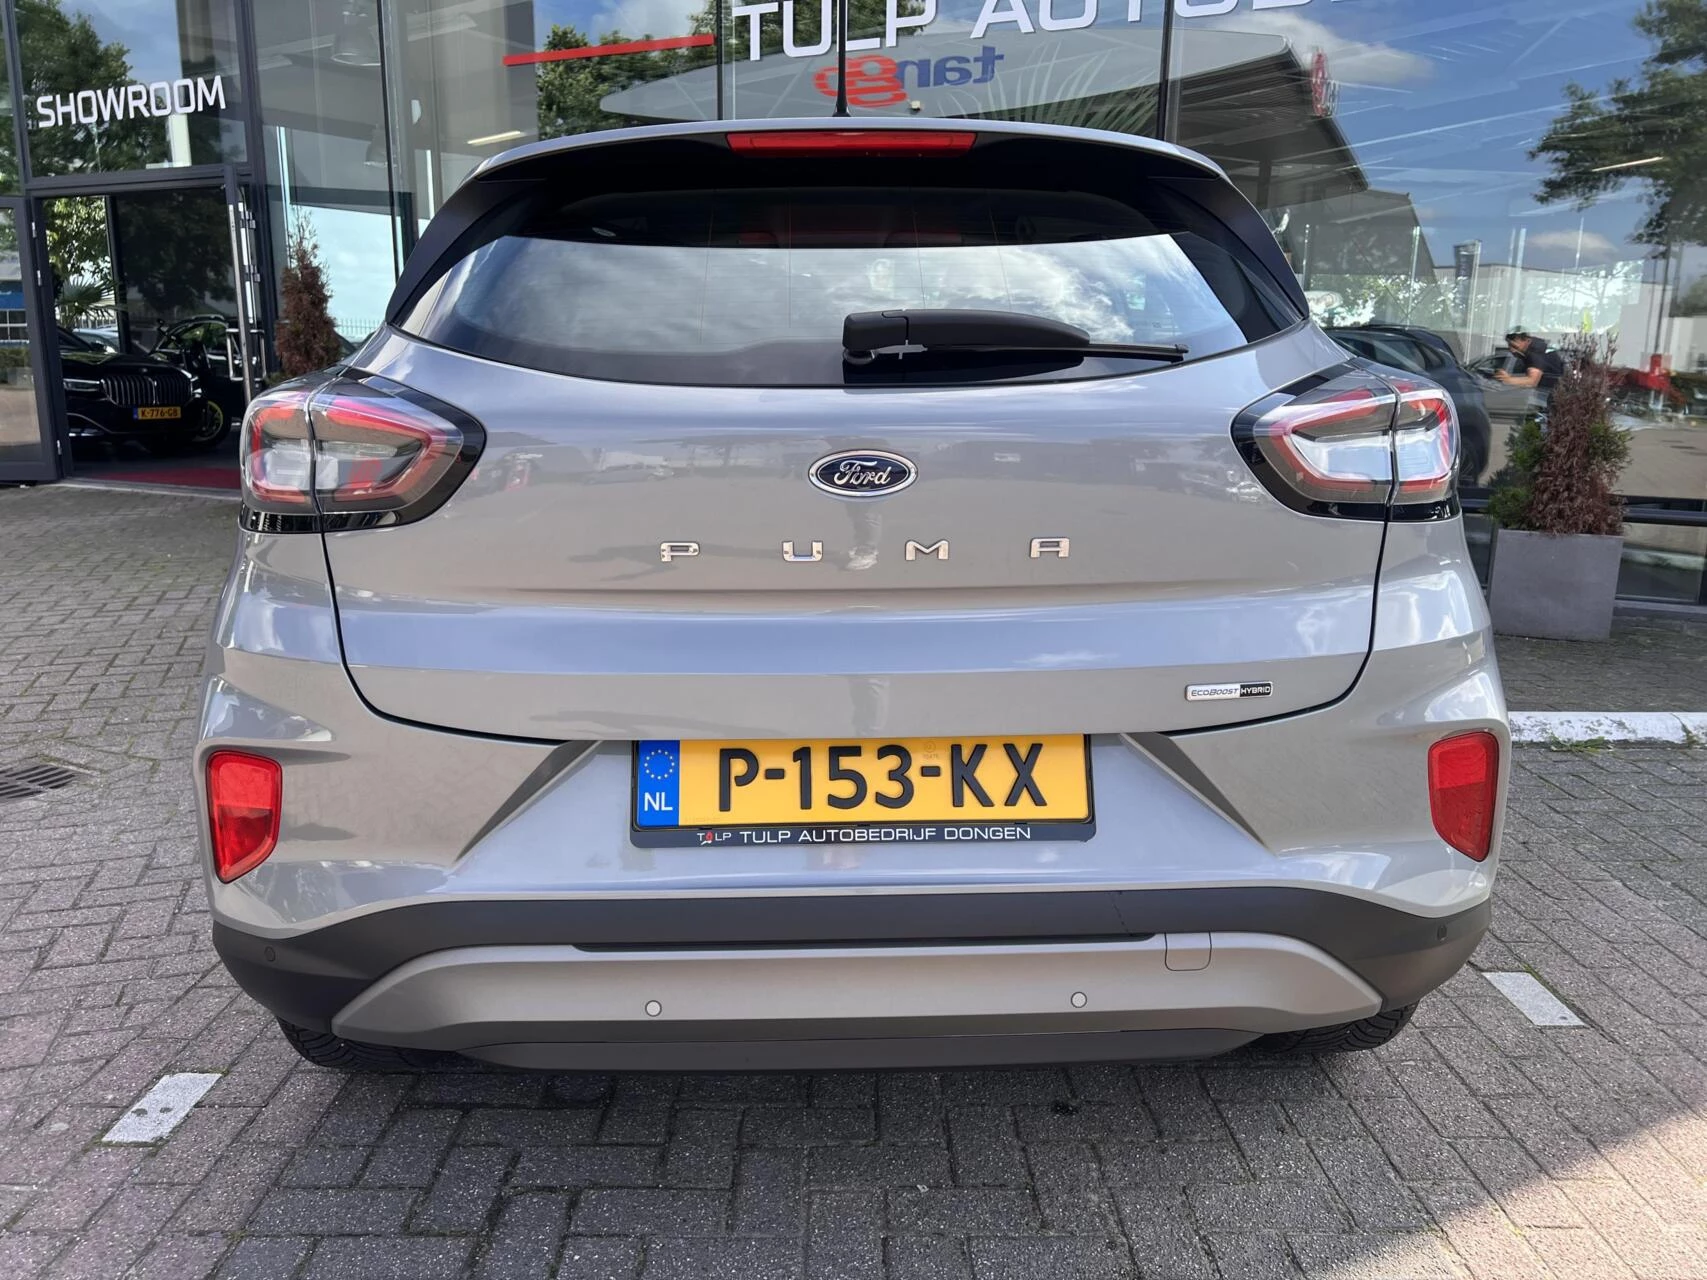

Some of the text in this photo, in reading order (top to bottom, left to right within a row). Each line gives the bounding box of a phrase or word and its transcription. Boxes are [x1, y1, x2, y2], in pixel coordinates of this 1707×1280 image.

[36, 75, 226, 128] SHOWROOM
[833, 460, 892, 485] Ford
[660, 537, 1070, 562] PUMA
[1240, 685, 1271, 695] HYBRID
[719, 743, 1048, 812] P-153-KX
[643, 792, 673, 812] NL
[739, 830, 791, 844] TULP
[798, 828, 937, 843] AUTOBEDRIJF
[944, 827, 1031, 840] DONGEN
